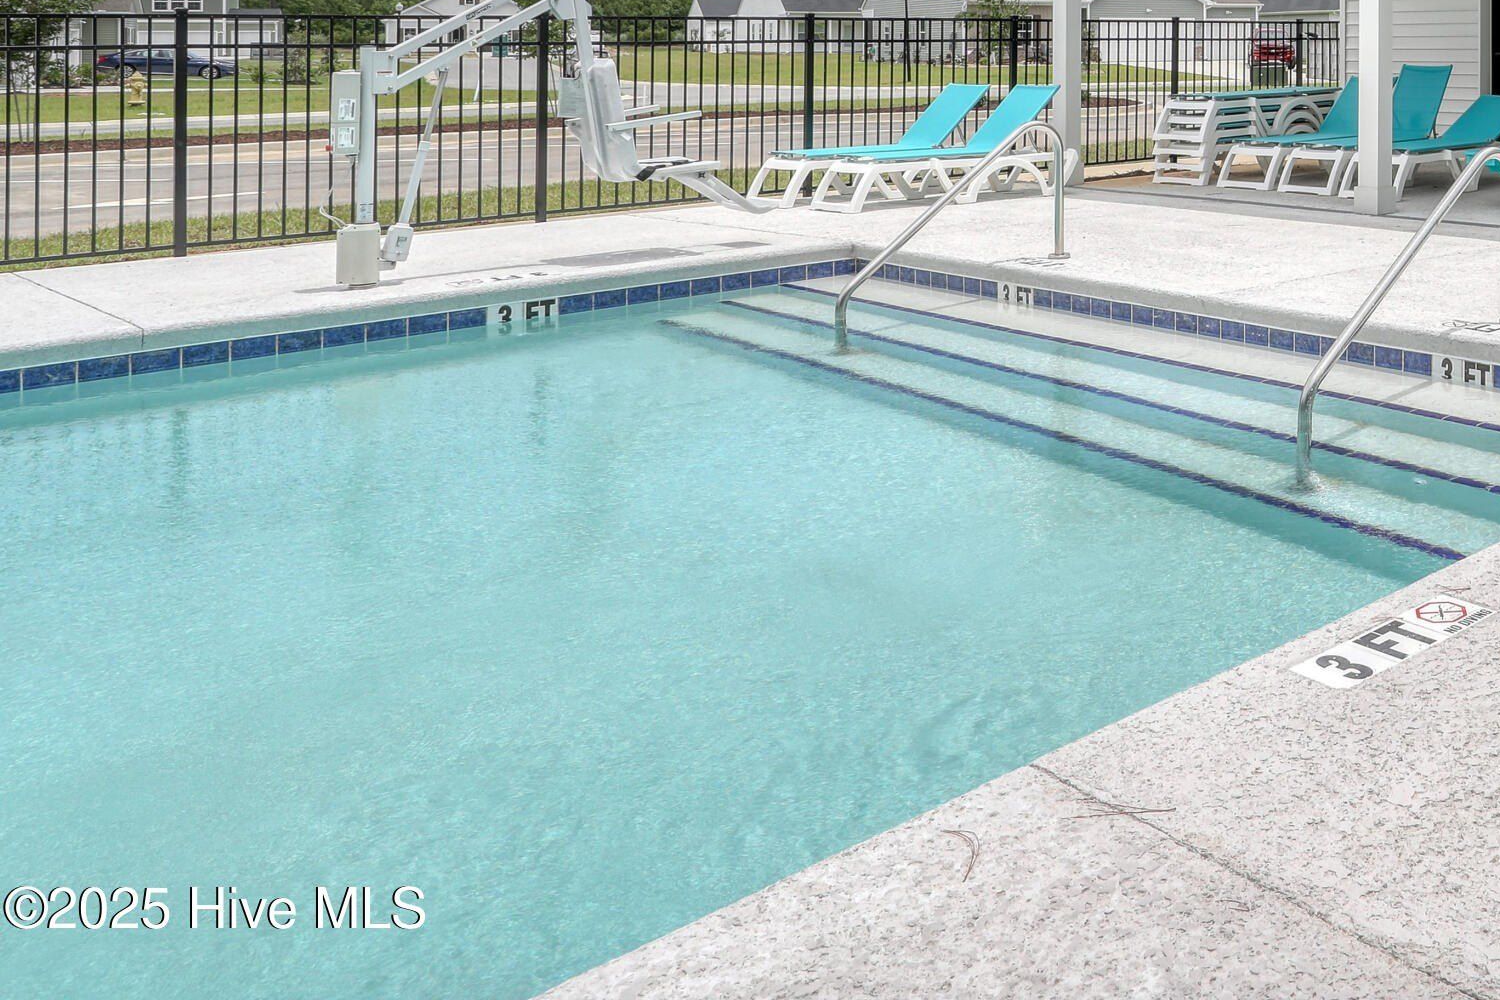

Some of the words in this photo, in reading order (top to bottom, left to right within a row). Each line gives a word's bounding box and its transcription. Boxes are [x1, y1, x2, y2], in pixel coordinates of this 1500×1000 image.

[1016, 286, 1032, 305] FT
[526, 299, 556, 320] FT
[1441, 357, 1453, 379] 3
[1464, 360, 1491, 386] FT
[1443, 624, 1463, 634] NO
[1457, 608, 1493, 627] DIVING
[1315, 654, 1374, 680] 3
[1352, 619, 1438, 660] FT
